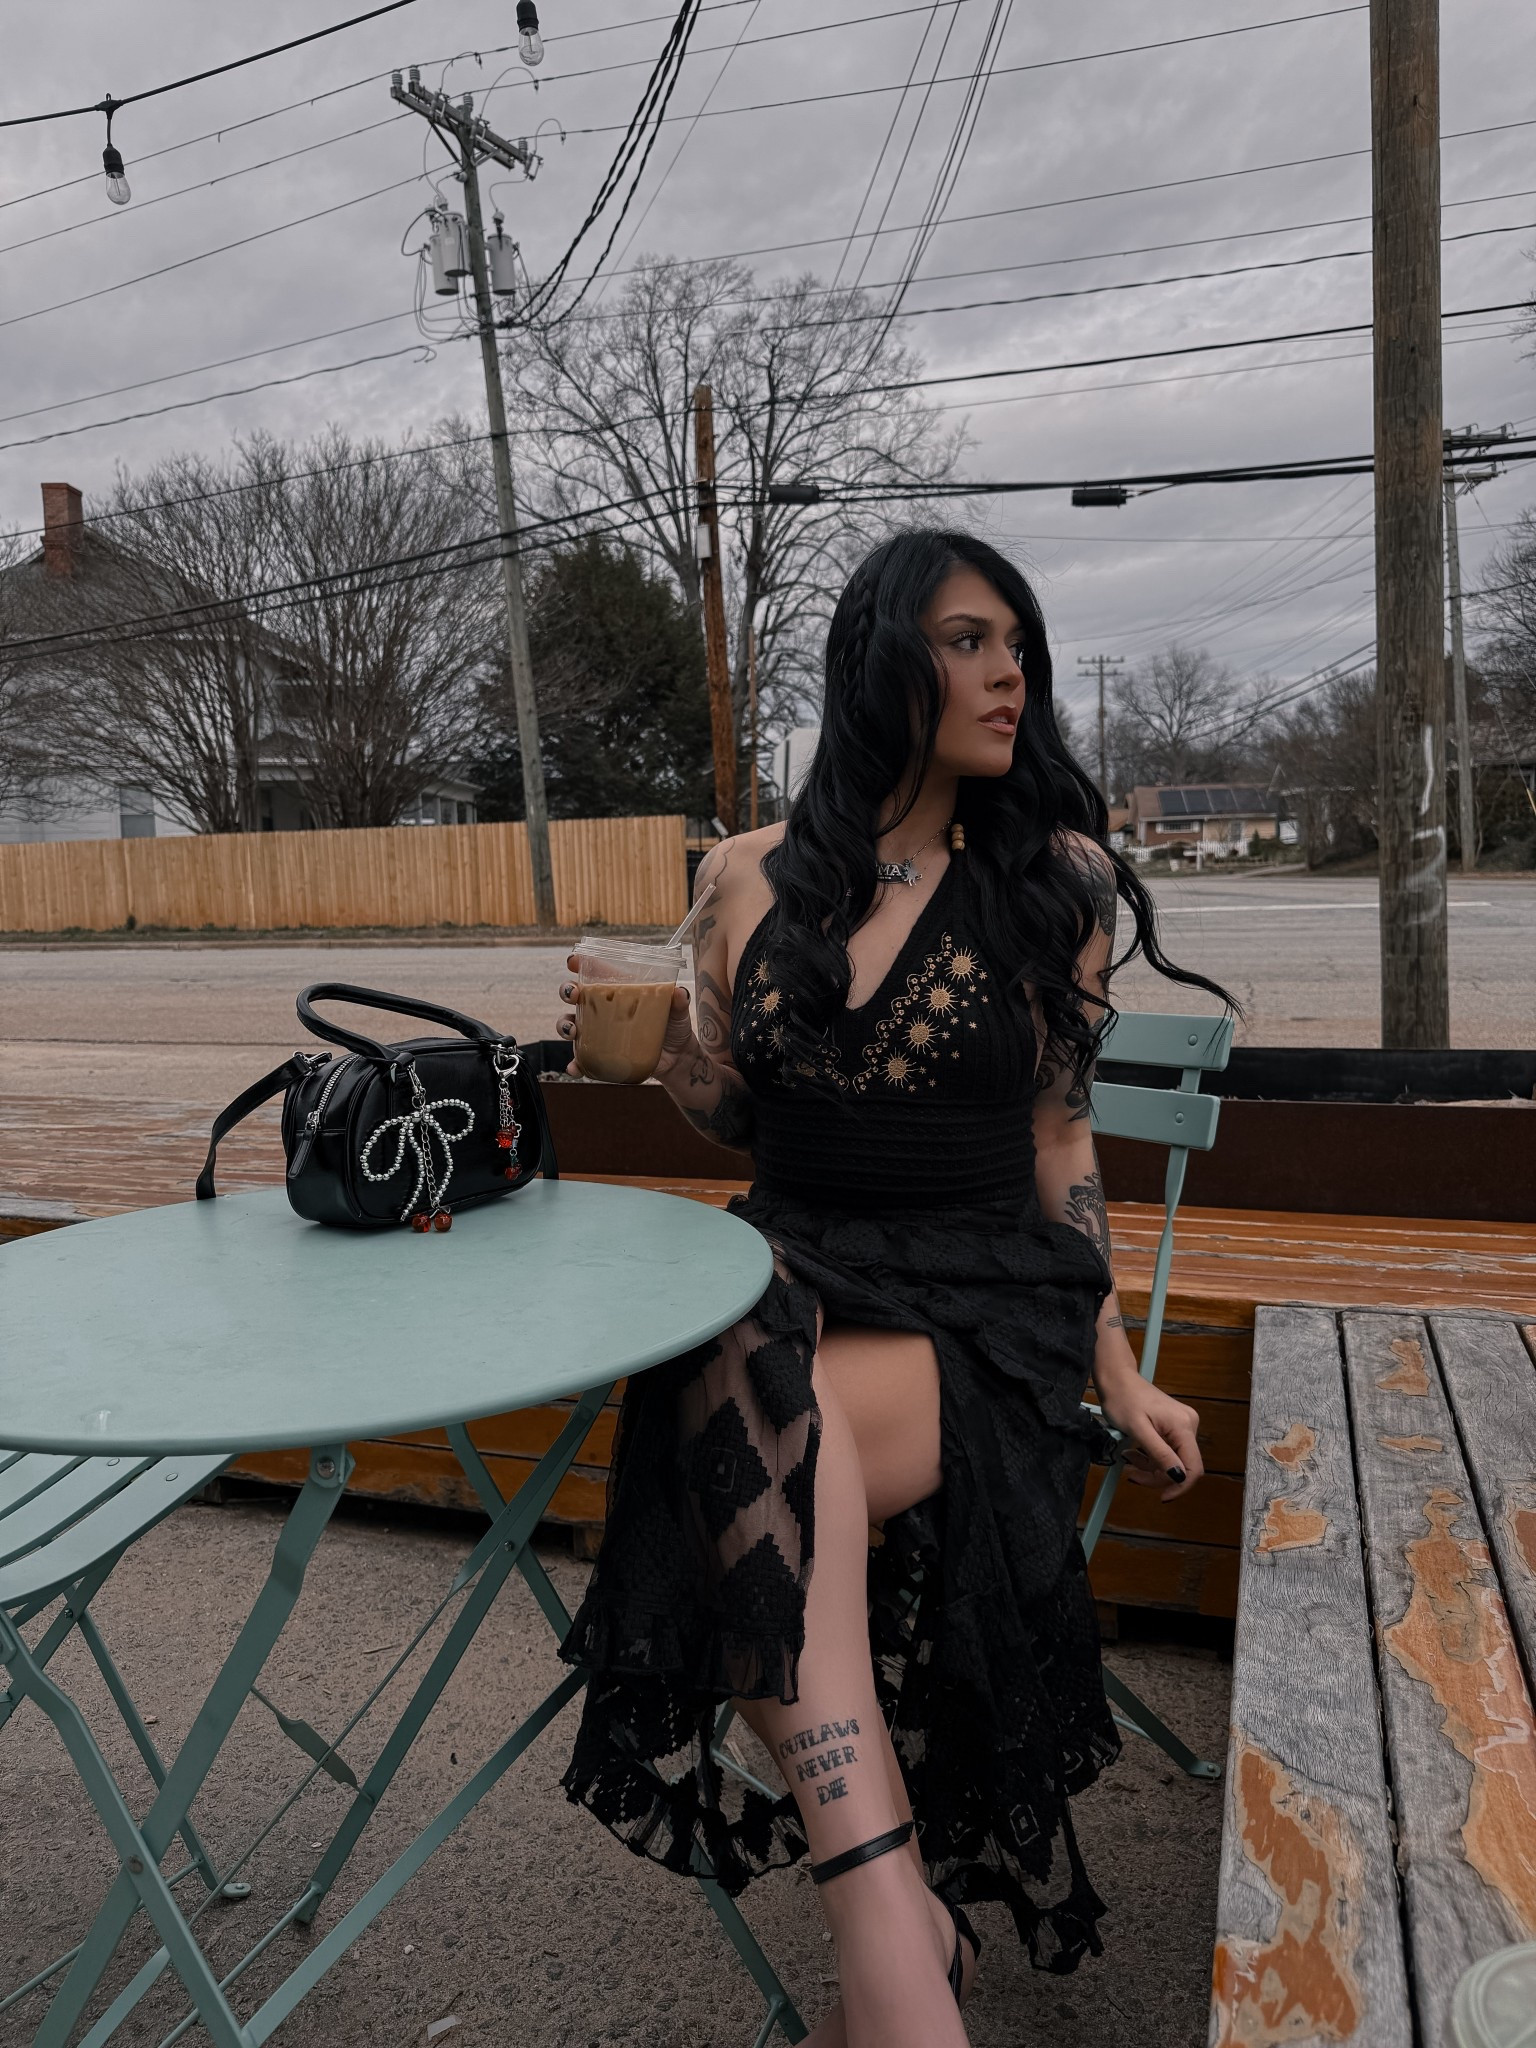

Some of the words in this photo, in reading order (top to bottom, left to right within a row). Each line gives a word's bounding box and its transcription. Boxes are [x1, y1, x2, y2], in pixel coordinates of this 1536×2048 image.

[778, 1719, 860, 1760] OUTLAWS
[795, 1746, 858, 1782] NEVER
[816, 1776, 849, 1806] DIE
